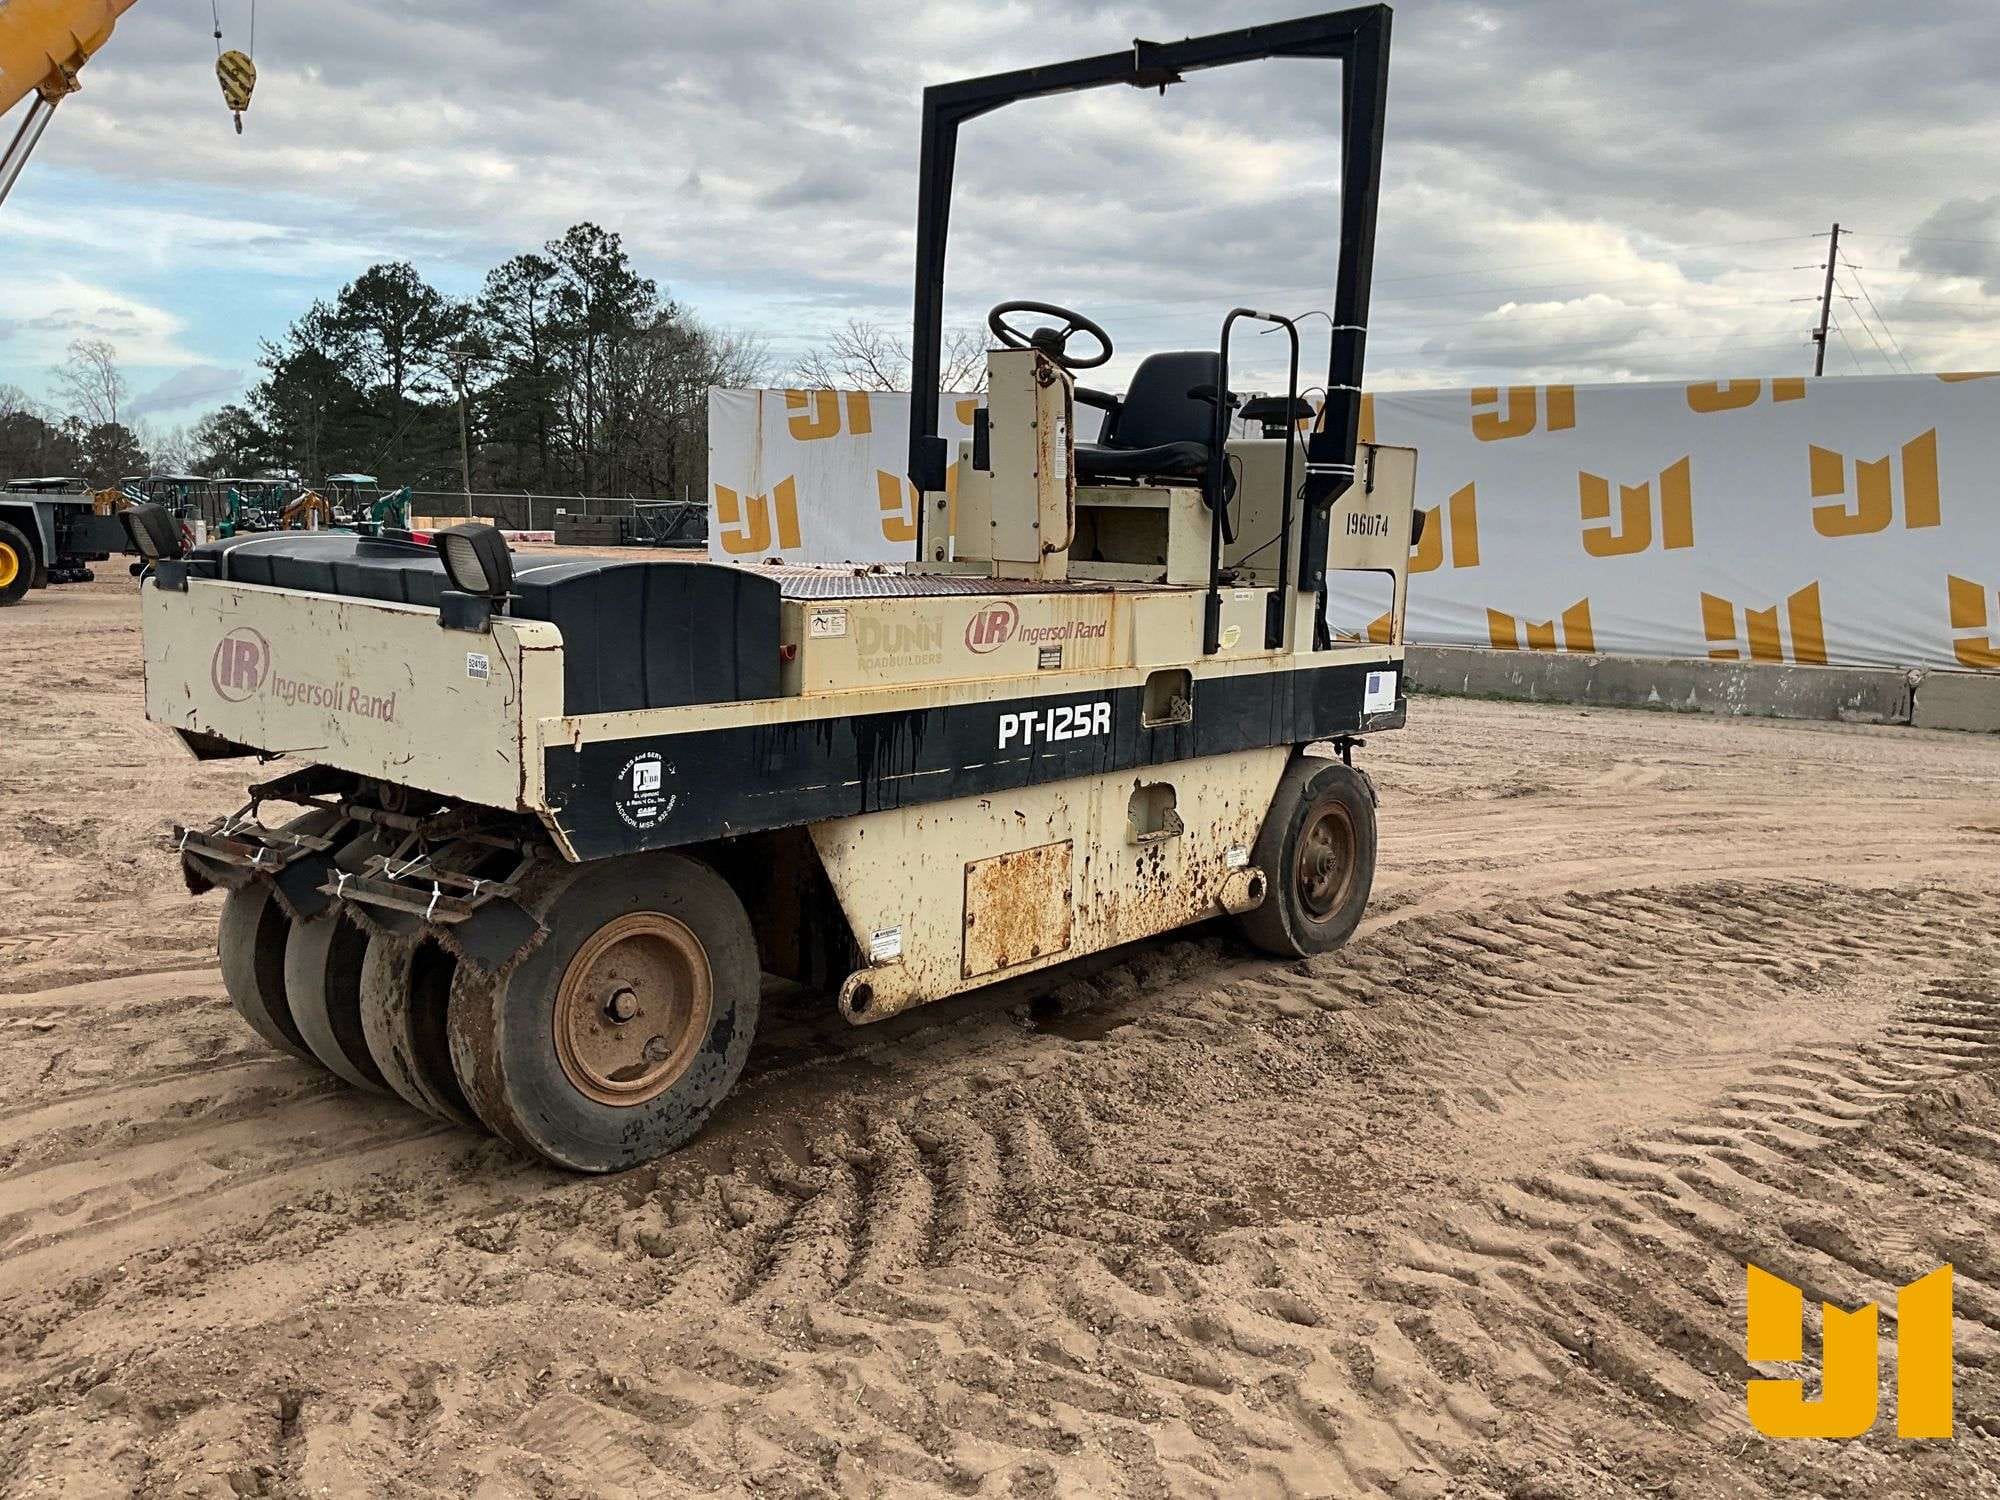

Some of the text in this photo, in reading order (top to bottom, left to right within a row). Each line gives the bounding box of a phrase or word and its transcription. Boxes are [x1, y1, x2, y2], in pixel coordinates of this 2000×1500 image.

[1346, 512, 1389, 537] 196074
[858, 616, 943, 656] DUNN
[972, 611, 1010, 645] IR
[1018, 620, 1108, 645] Ingersoll Rand
[220, 637, 260, 692] IR
[857, 653, 943, 670] ROADBUILDERS
[271, 670, 397, 722] Ingersoll Rand
[998, 702, 1111, 749] PT-125R
